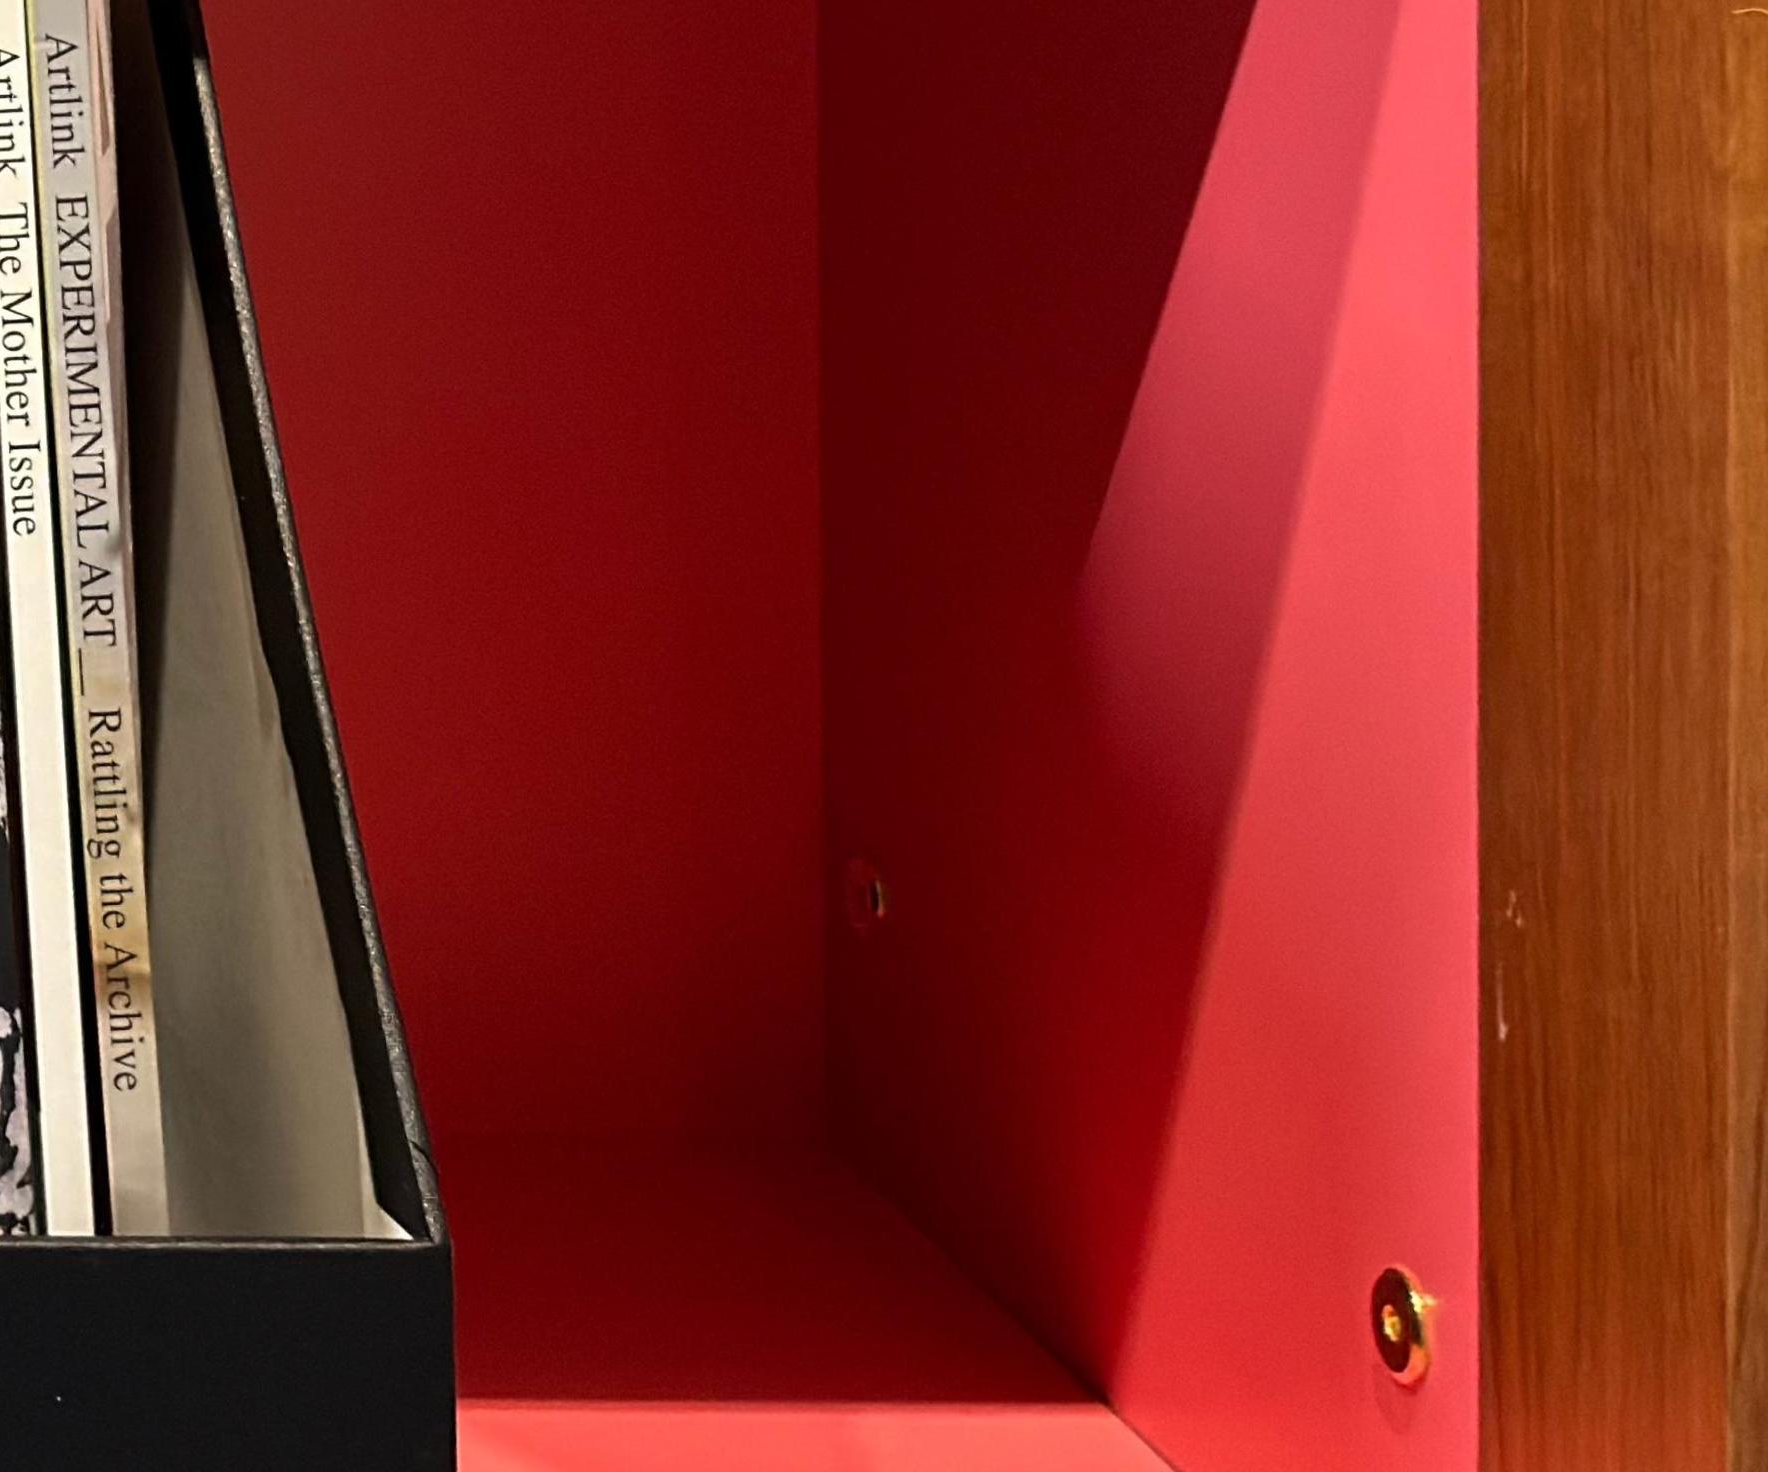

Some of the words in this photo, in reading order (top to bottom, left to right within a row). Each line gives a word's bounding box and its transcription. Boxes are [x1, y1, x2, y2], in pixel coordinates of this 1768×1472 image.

[44, 33, 84, 169] Artlink
[54, 195, 111, 550] EXPERIMENTAL
[7, 441, 41, 536] Issue
[88, 708, 126, 857] Rattling
[101, 871, 132, 929] the
[105, 942, 145, 1091] Archive
